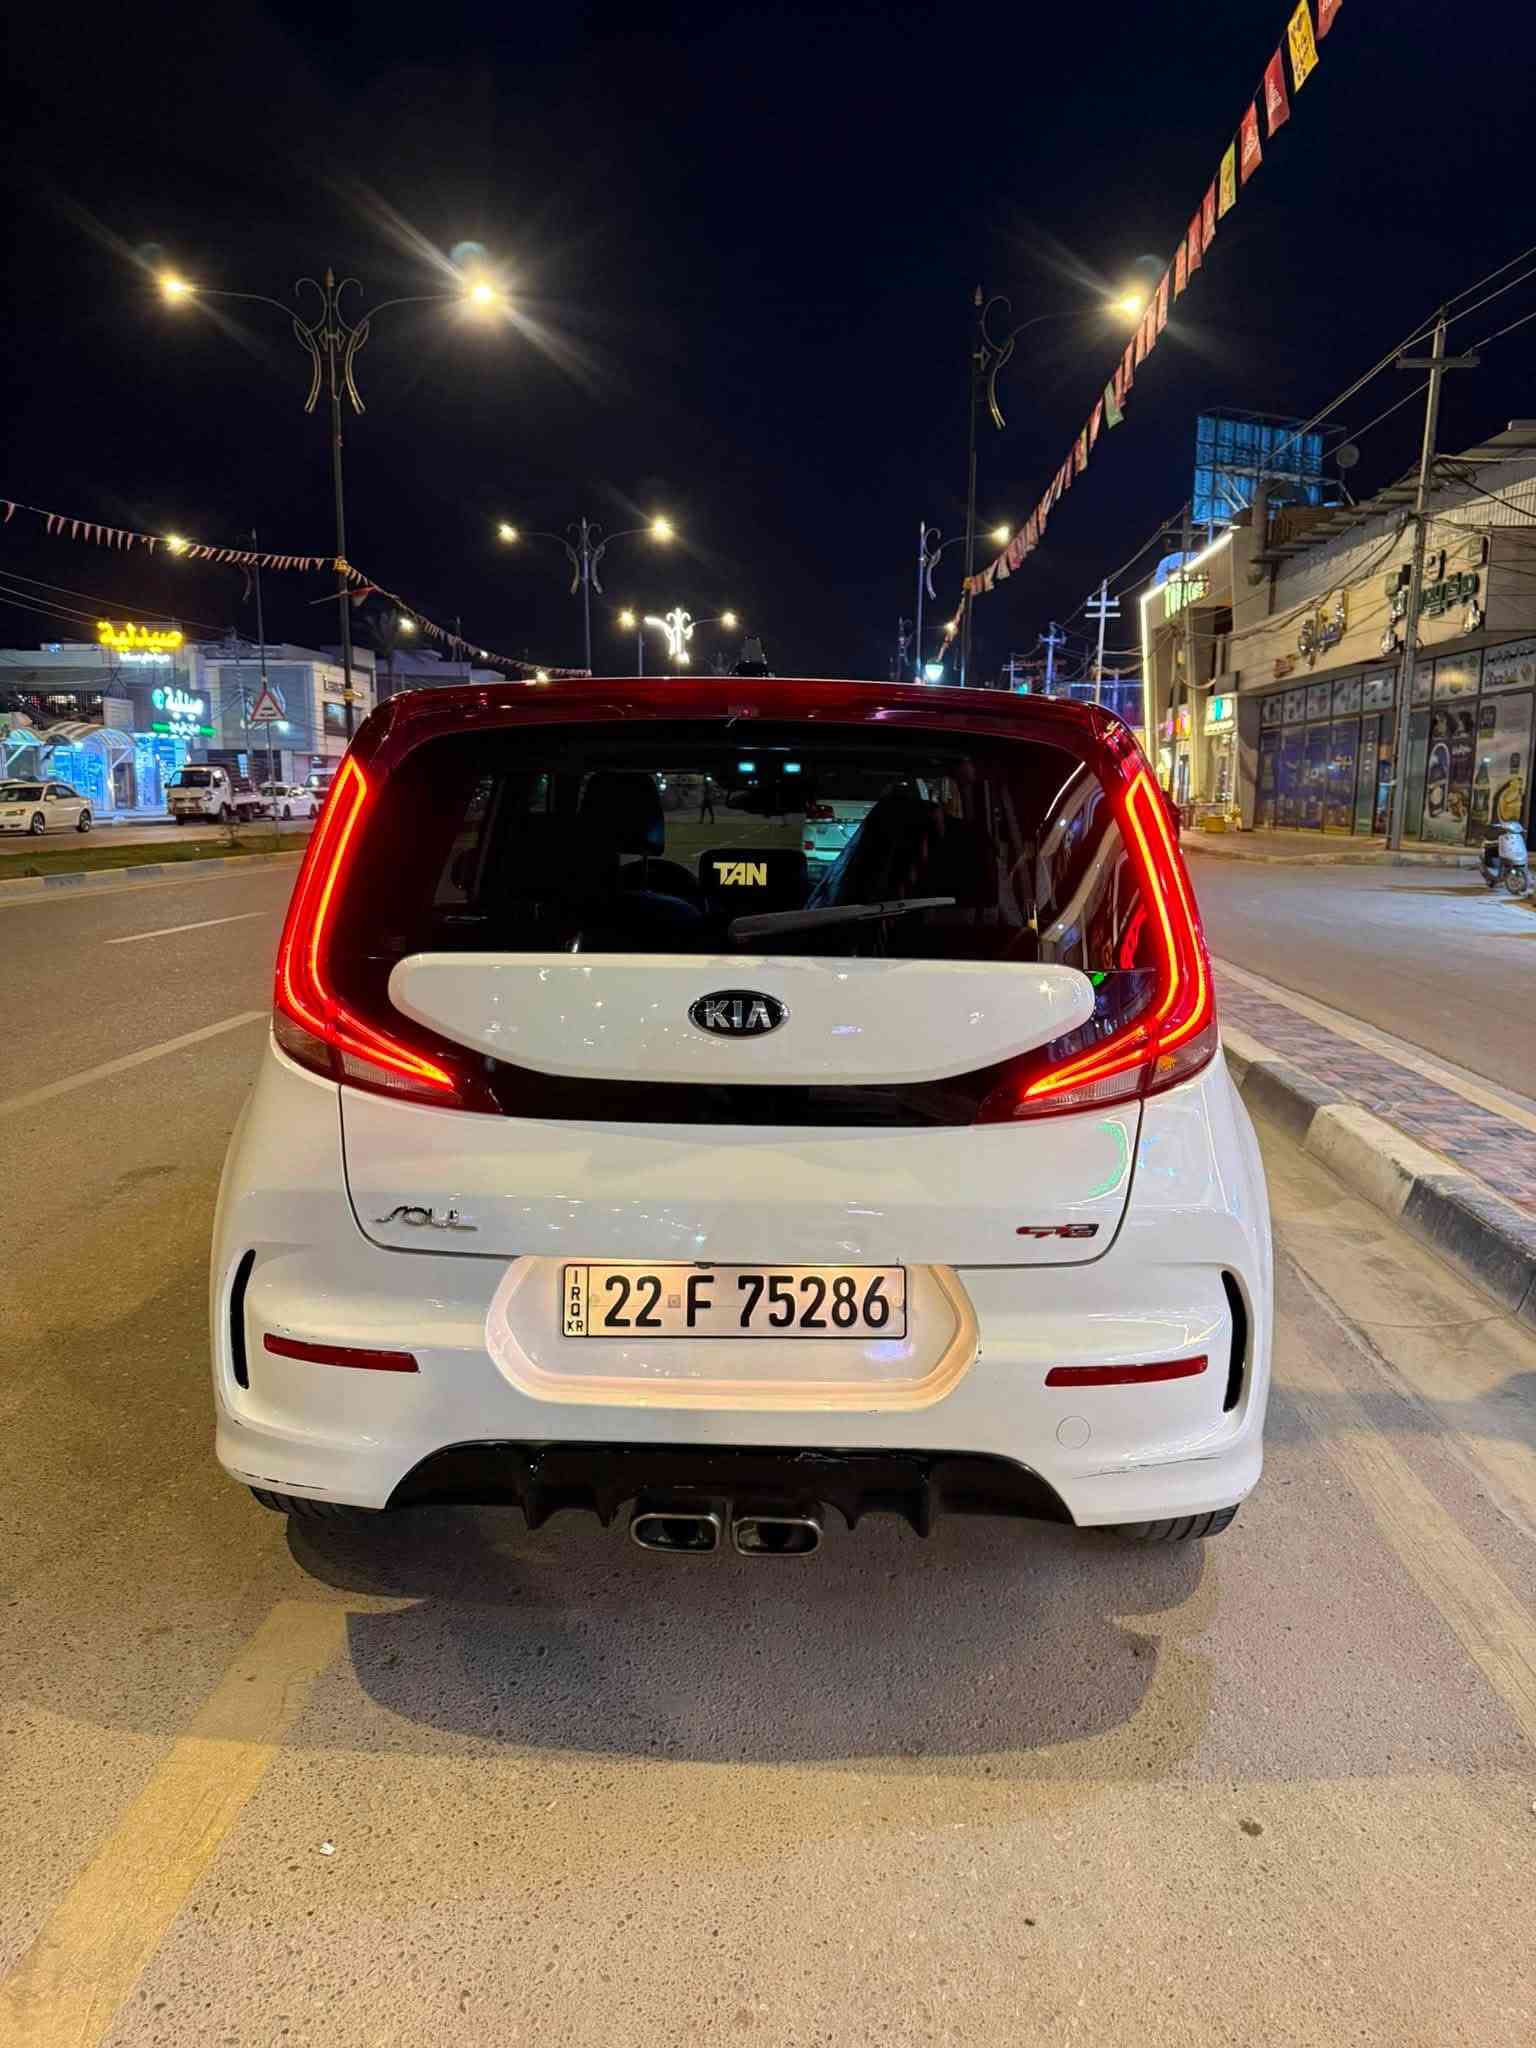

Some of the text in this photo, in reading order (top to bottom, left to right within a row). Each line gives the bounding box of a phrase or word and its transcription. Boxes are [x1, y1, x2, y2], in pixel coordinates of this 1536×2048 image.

[713, 862, 767, 886] TAN
[705, 1000, 772, 1028] KIA
[604, 1275, 890, 1328] 22 F 75286
[567, 1320, 584, 1332] KR
